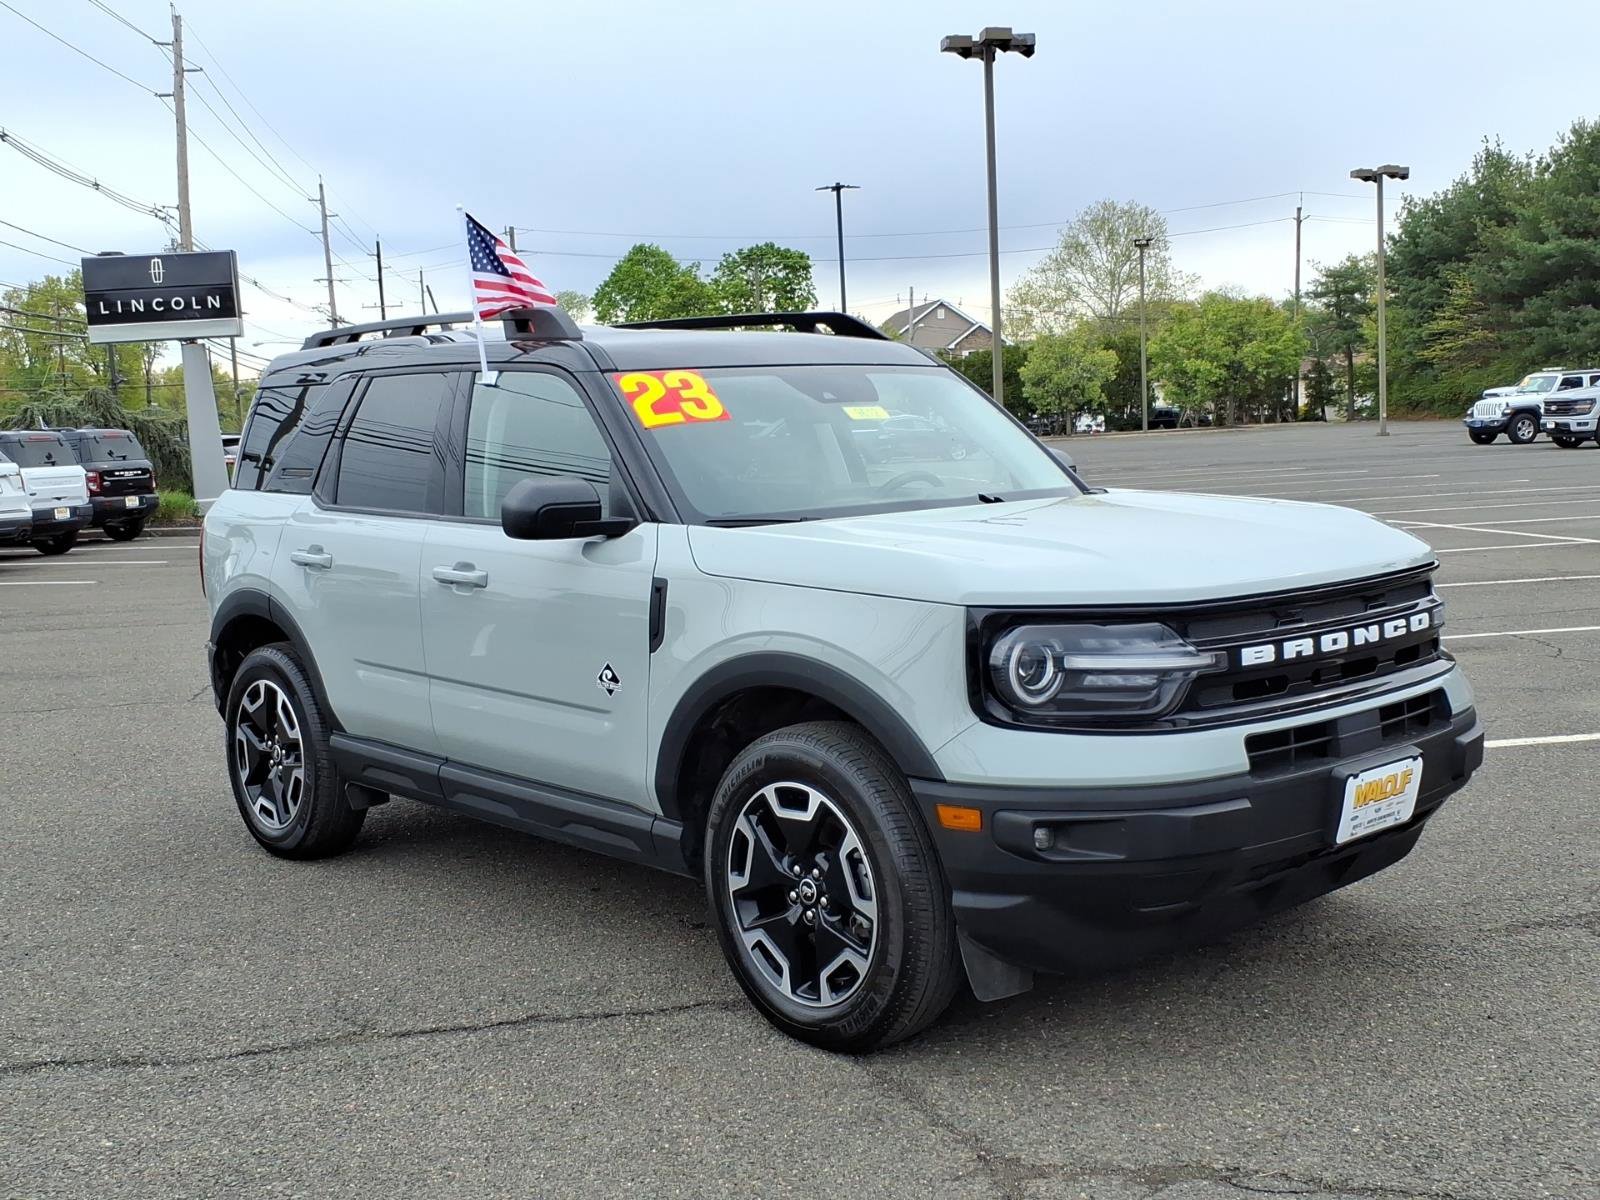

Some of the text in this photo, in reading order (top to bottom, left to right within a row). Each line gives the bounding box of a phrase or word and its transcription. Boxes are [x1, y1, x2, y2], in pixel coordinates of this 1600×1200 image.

[99, 295, 221, 315] LINCOLN
[619, 370, 724, 429] 23
[1240, 612, 1430, 666] BRONCO
[1353, 768, 1413, 809] MALOUF
